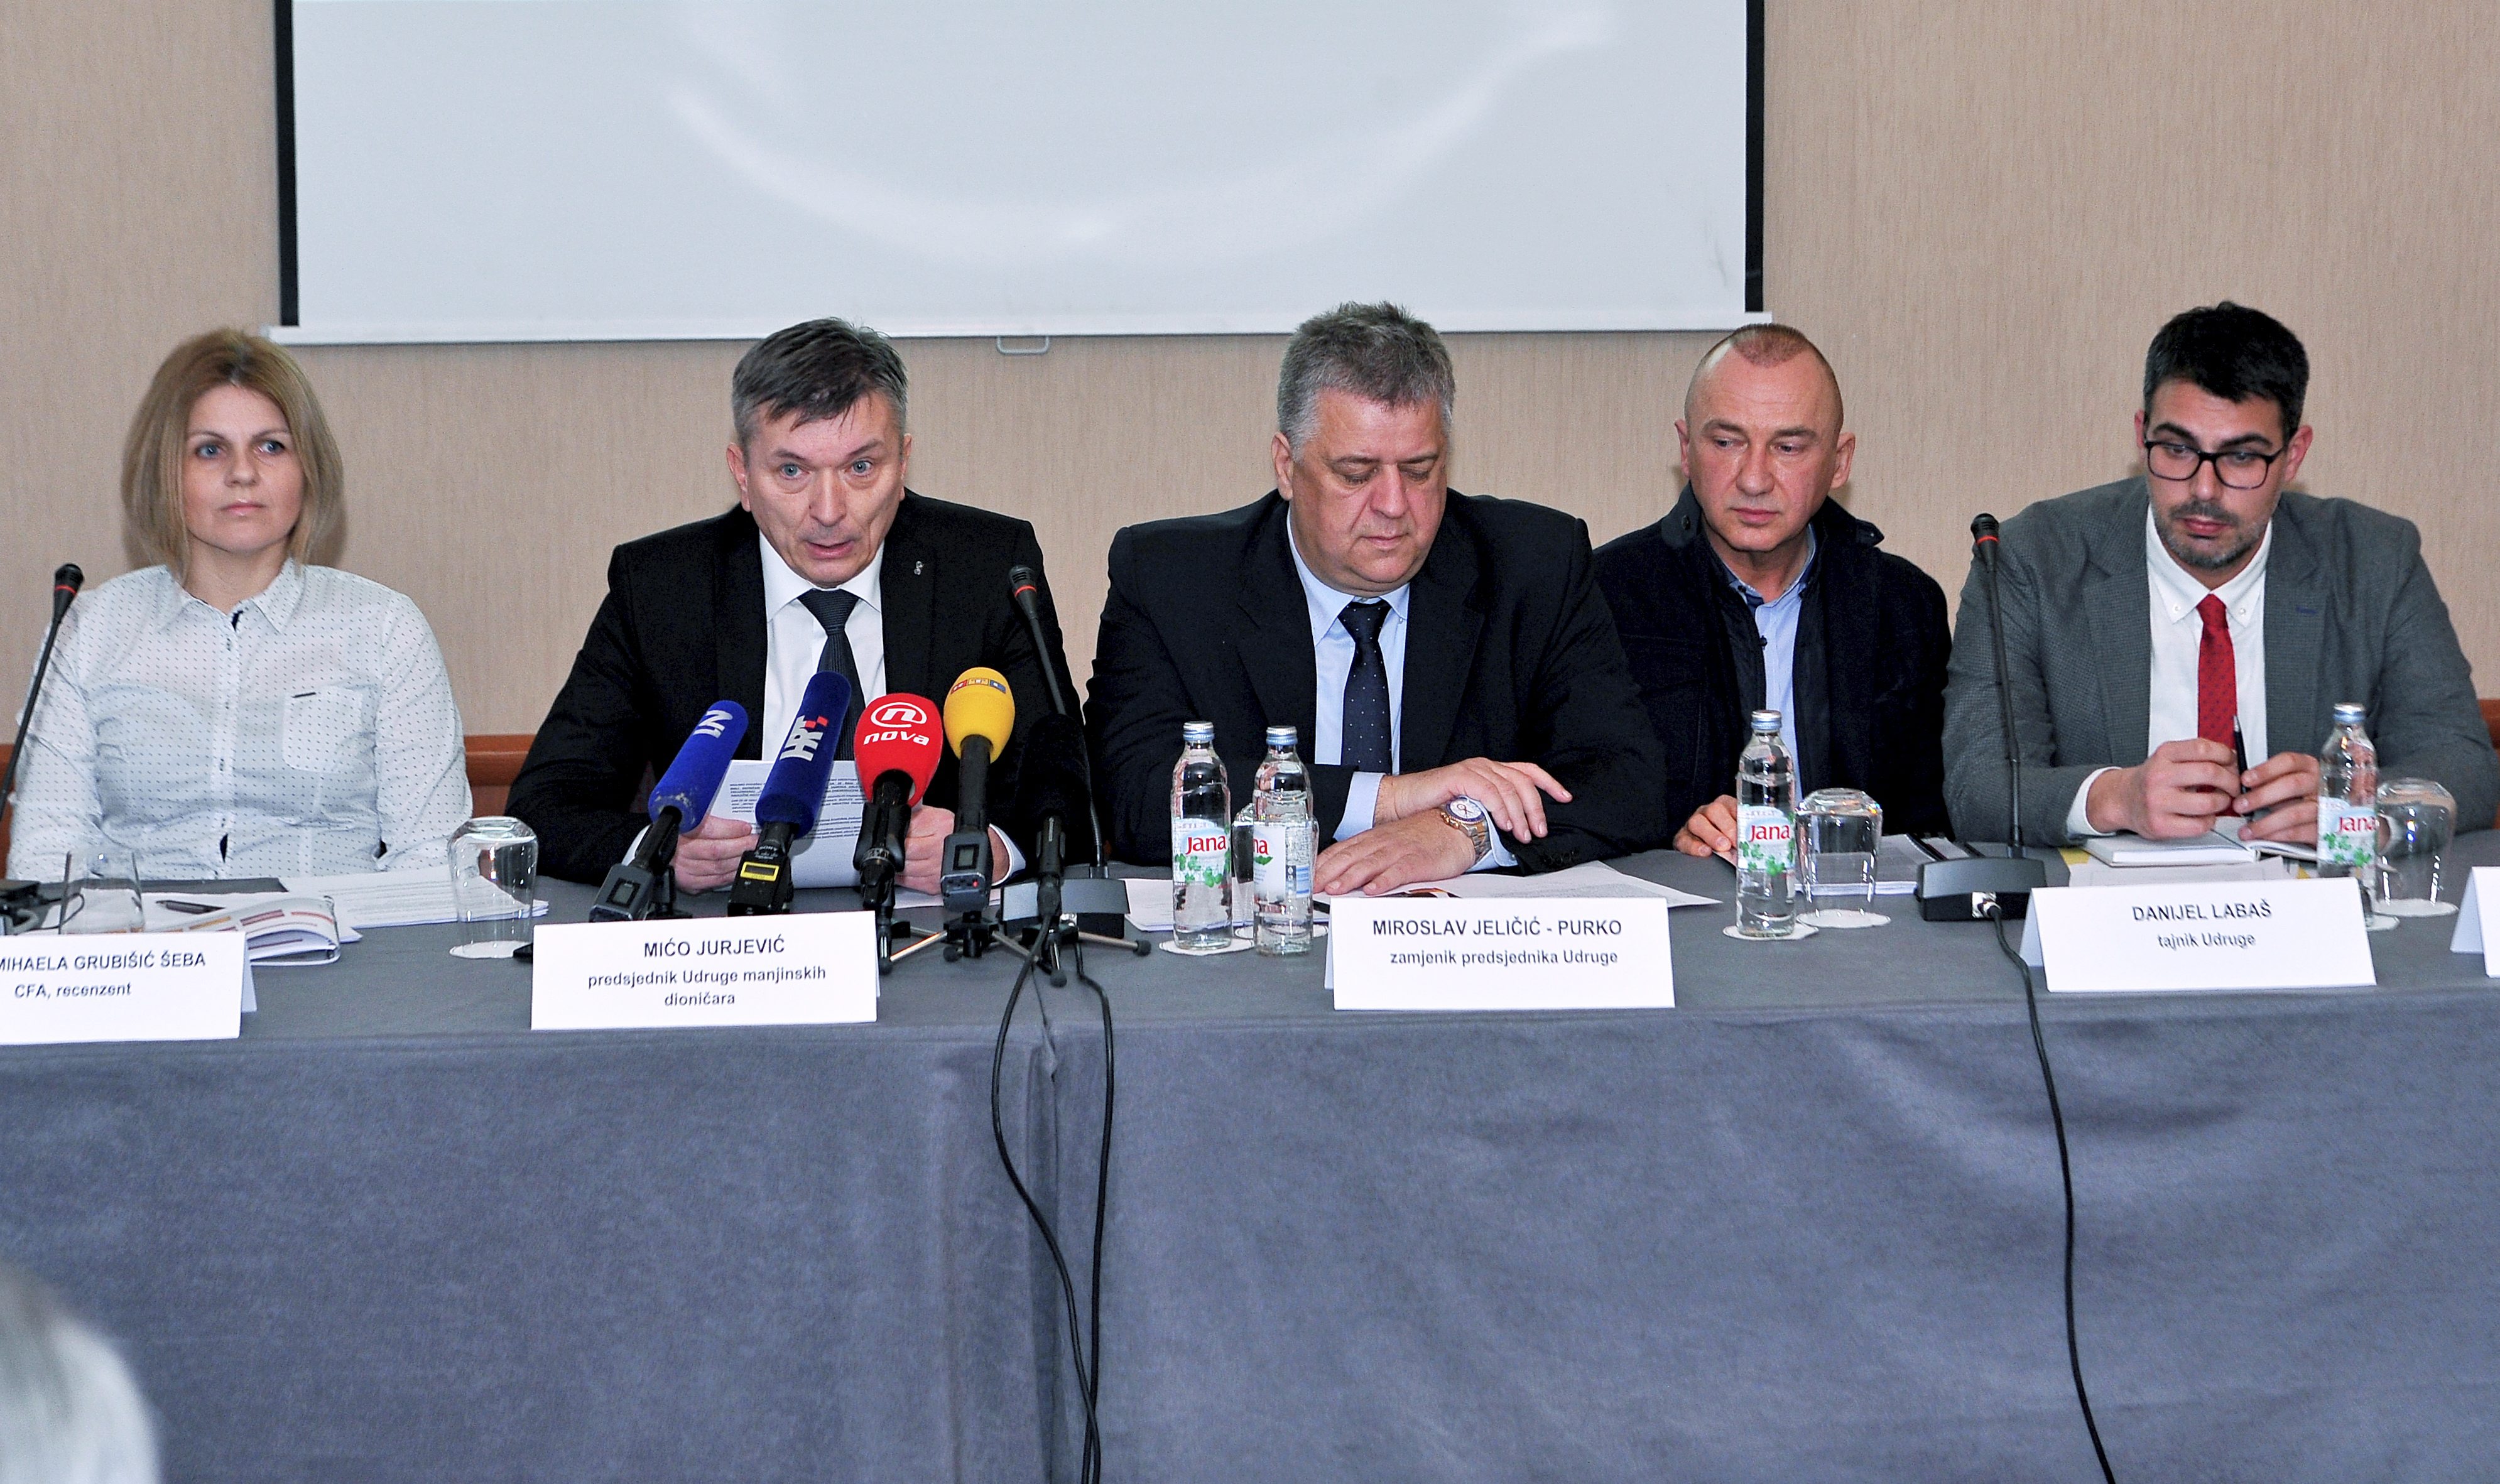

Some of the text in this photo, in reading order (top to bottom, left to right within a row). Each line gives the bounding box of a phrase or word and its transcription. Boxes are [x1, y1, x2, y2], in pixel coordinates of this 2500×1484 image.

[863, 730, 930, 746] nova
[1748, 825, 1790, 842] Jana
[1185, 835, 1227, 855] Jana
[2132, 897, 2272, 921] DANIJEL LABAŠ
[1372, 919, 1467, 936] MIROSLAV
[1472, 916, 1541, 936] JELIČIĆ
[1558, 919, 1622, 935] PURKO
[644, 934, 785, 958] MIĆO JURJEVIĆ
[2156, 932, 2256, 950] tajnik Udruge
[73, 950, 156, 970] GRUBIŠIĆ
[160, 949, 207, 968] ŠEBA
[1390, 950, 1618, 967] zamjenik predsjednika Udruge
[588, 965, 826, 990] predsjednik Udruge manjinskih
[14, 981, 132, 1000] CFA, recenzent
[664, 992, 736, 1007] dioničara
